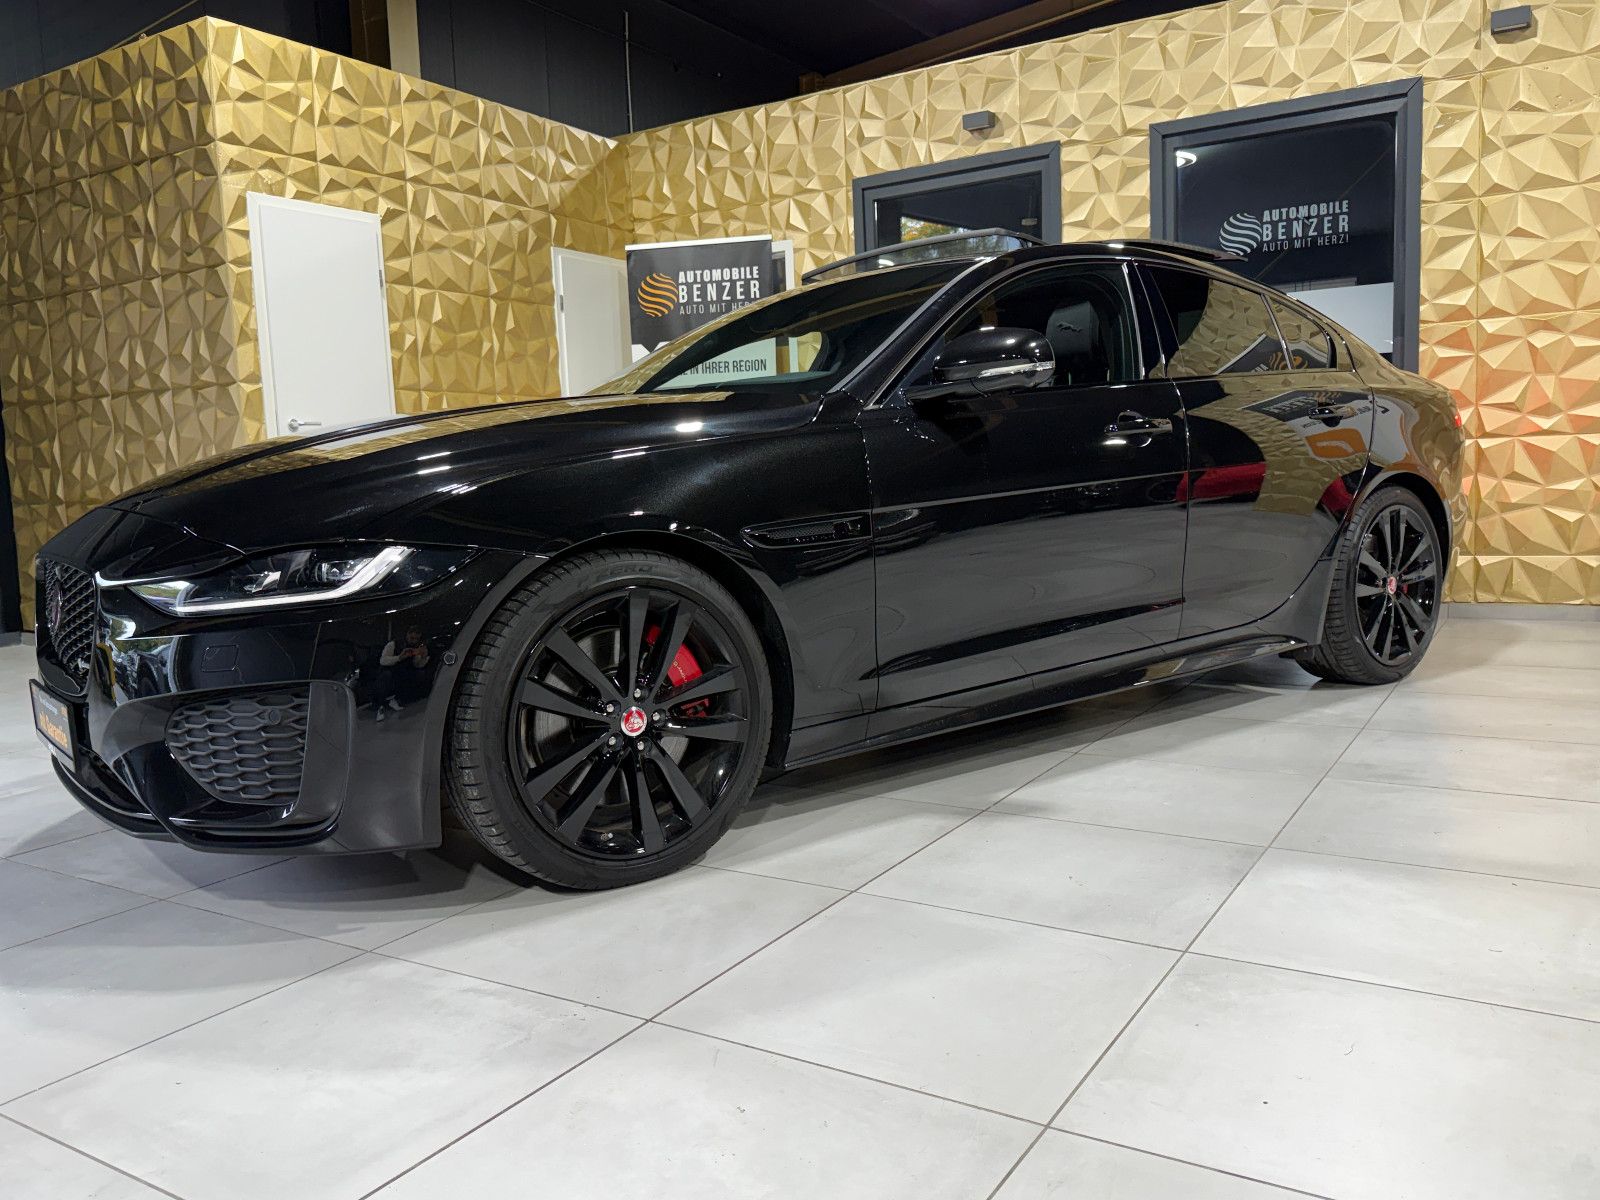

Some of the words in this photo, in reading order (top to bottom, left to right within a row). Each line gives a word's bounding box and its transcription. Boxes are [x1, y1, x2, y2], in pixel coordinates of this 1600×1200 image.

[1263, 200, 1349, 222] AUTOMOBILE
[1263, 215, 1349, 242] BENZER
[1263, 241, 1289, 253] AUTO
[1294, 237, 1312, 249] MIT
[679, 266, 760, 284] AUTOMOBILE
[679, 280, 760, 303] BENZER
[680, 304, 705, 315] AUTO
[709, 302, 726, 314] MIT
[702, 361, 730, 374] IHRER
[732, 359, 767, 373] REGION
